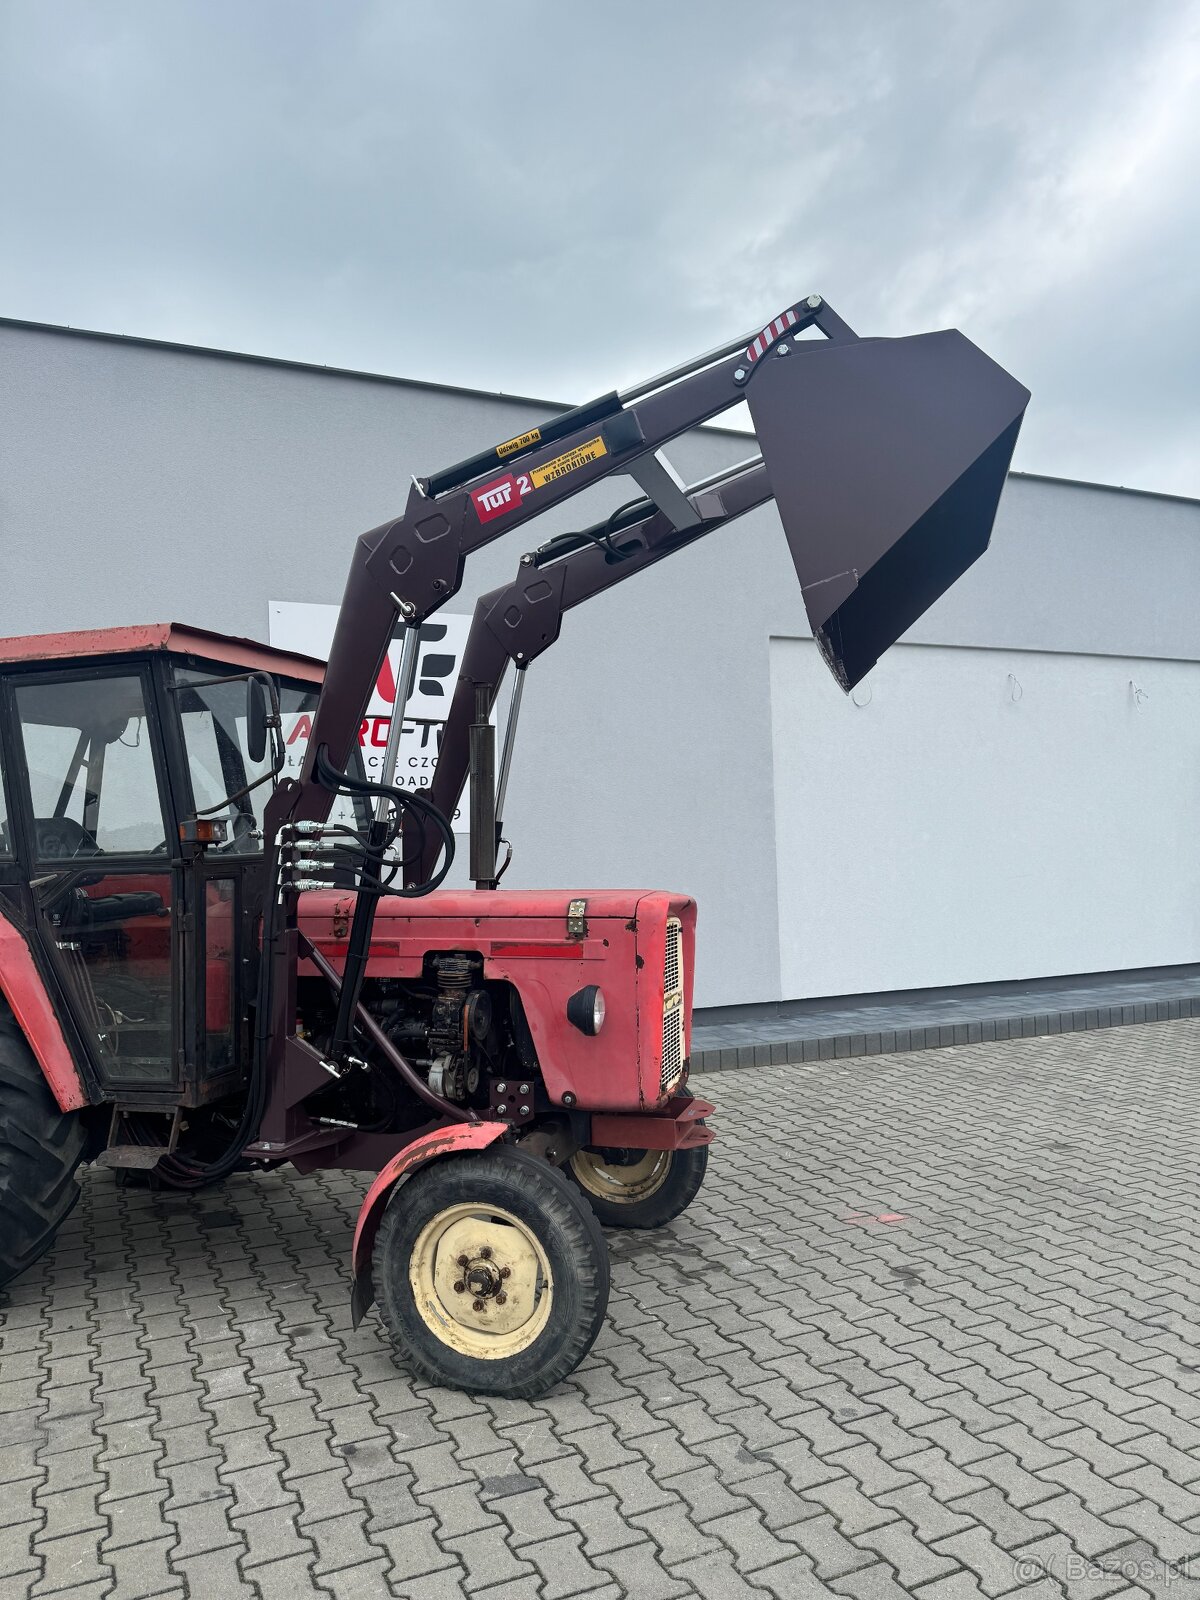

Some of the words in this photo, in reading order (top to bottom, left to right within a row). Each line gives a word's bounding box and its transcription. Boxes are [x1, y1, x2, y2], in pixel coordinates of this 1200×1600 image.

[519, 434, 531, 446] 700
[531, 431, 540, 441] kg
[543, 450, 597, 483] WZBRONIONE
[516, 475, 532, 496] 2
